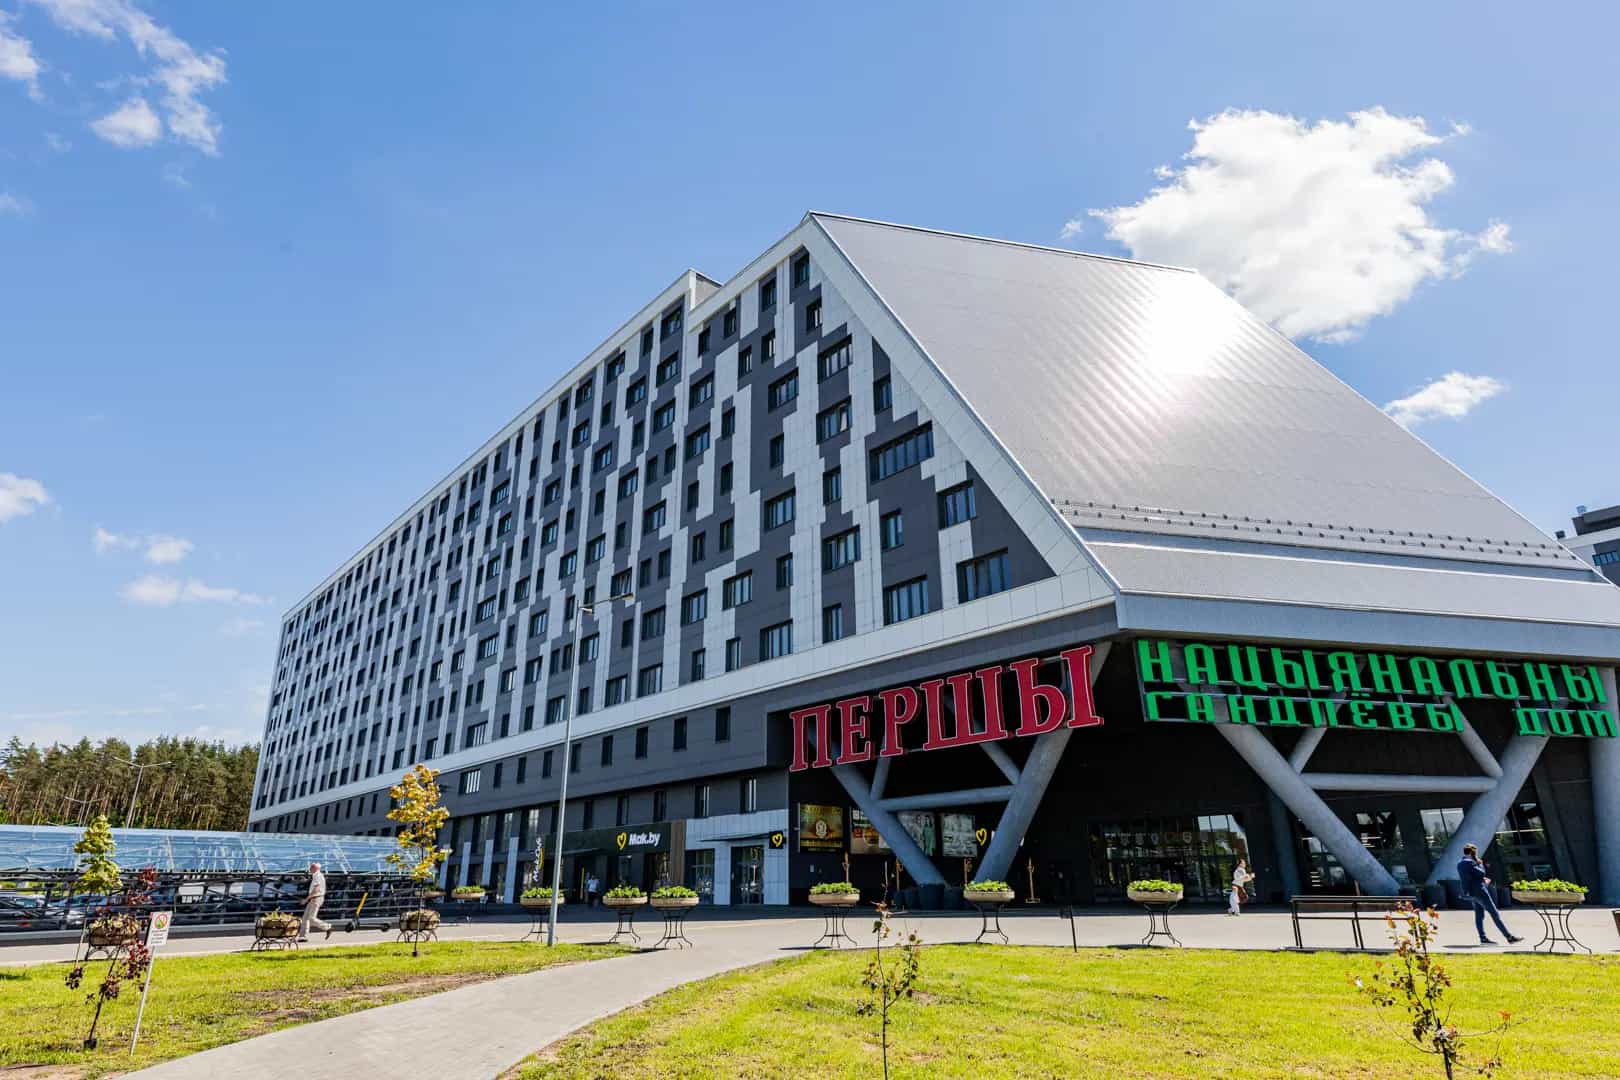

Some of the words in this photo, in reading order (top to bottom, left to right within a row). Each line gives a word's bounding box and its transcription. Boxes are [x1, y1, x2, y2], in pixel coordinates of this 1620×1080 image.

[1138, 639, 1608, 704] НАЦЫЯНАЛЬНЫ
[788, 645, 1103, 772] ПЕРШЫ
[1144, 690, 1465, 732] ГАНДЛЁВЫ
[1516, 707, 1617, 736] ДОМ
[628, 831, 661, 847] Mak.by
